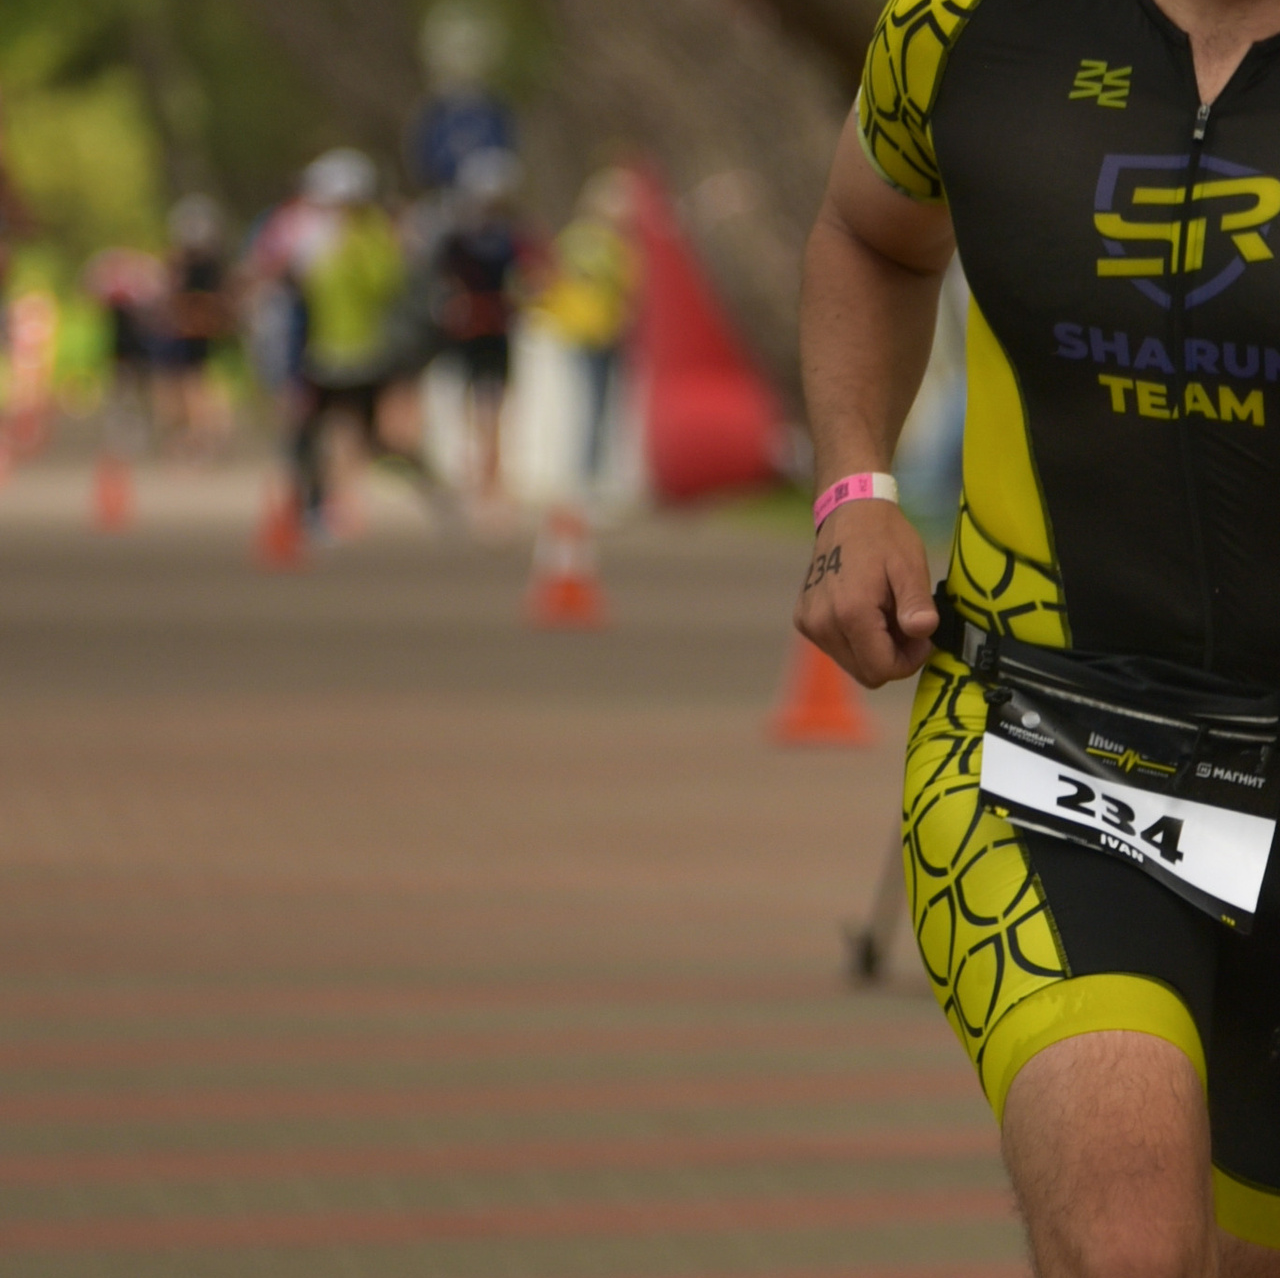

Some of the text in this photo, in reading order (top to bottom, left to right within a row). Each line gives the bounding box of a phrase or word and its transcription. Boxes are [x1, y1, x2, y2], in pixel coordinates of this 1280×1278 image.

[1098, 373, 1265, 426] TEAM
[1212, 766, 1266, 789] МАГНИТ
[1056, 773, 1185, 865] 234
[1100, 832, 1145, 864] IVAN
